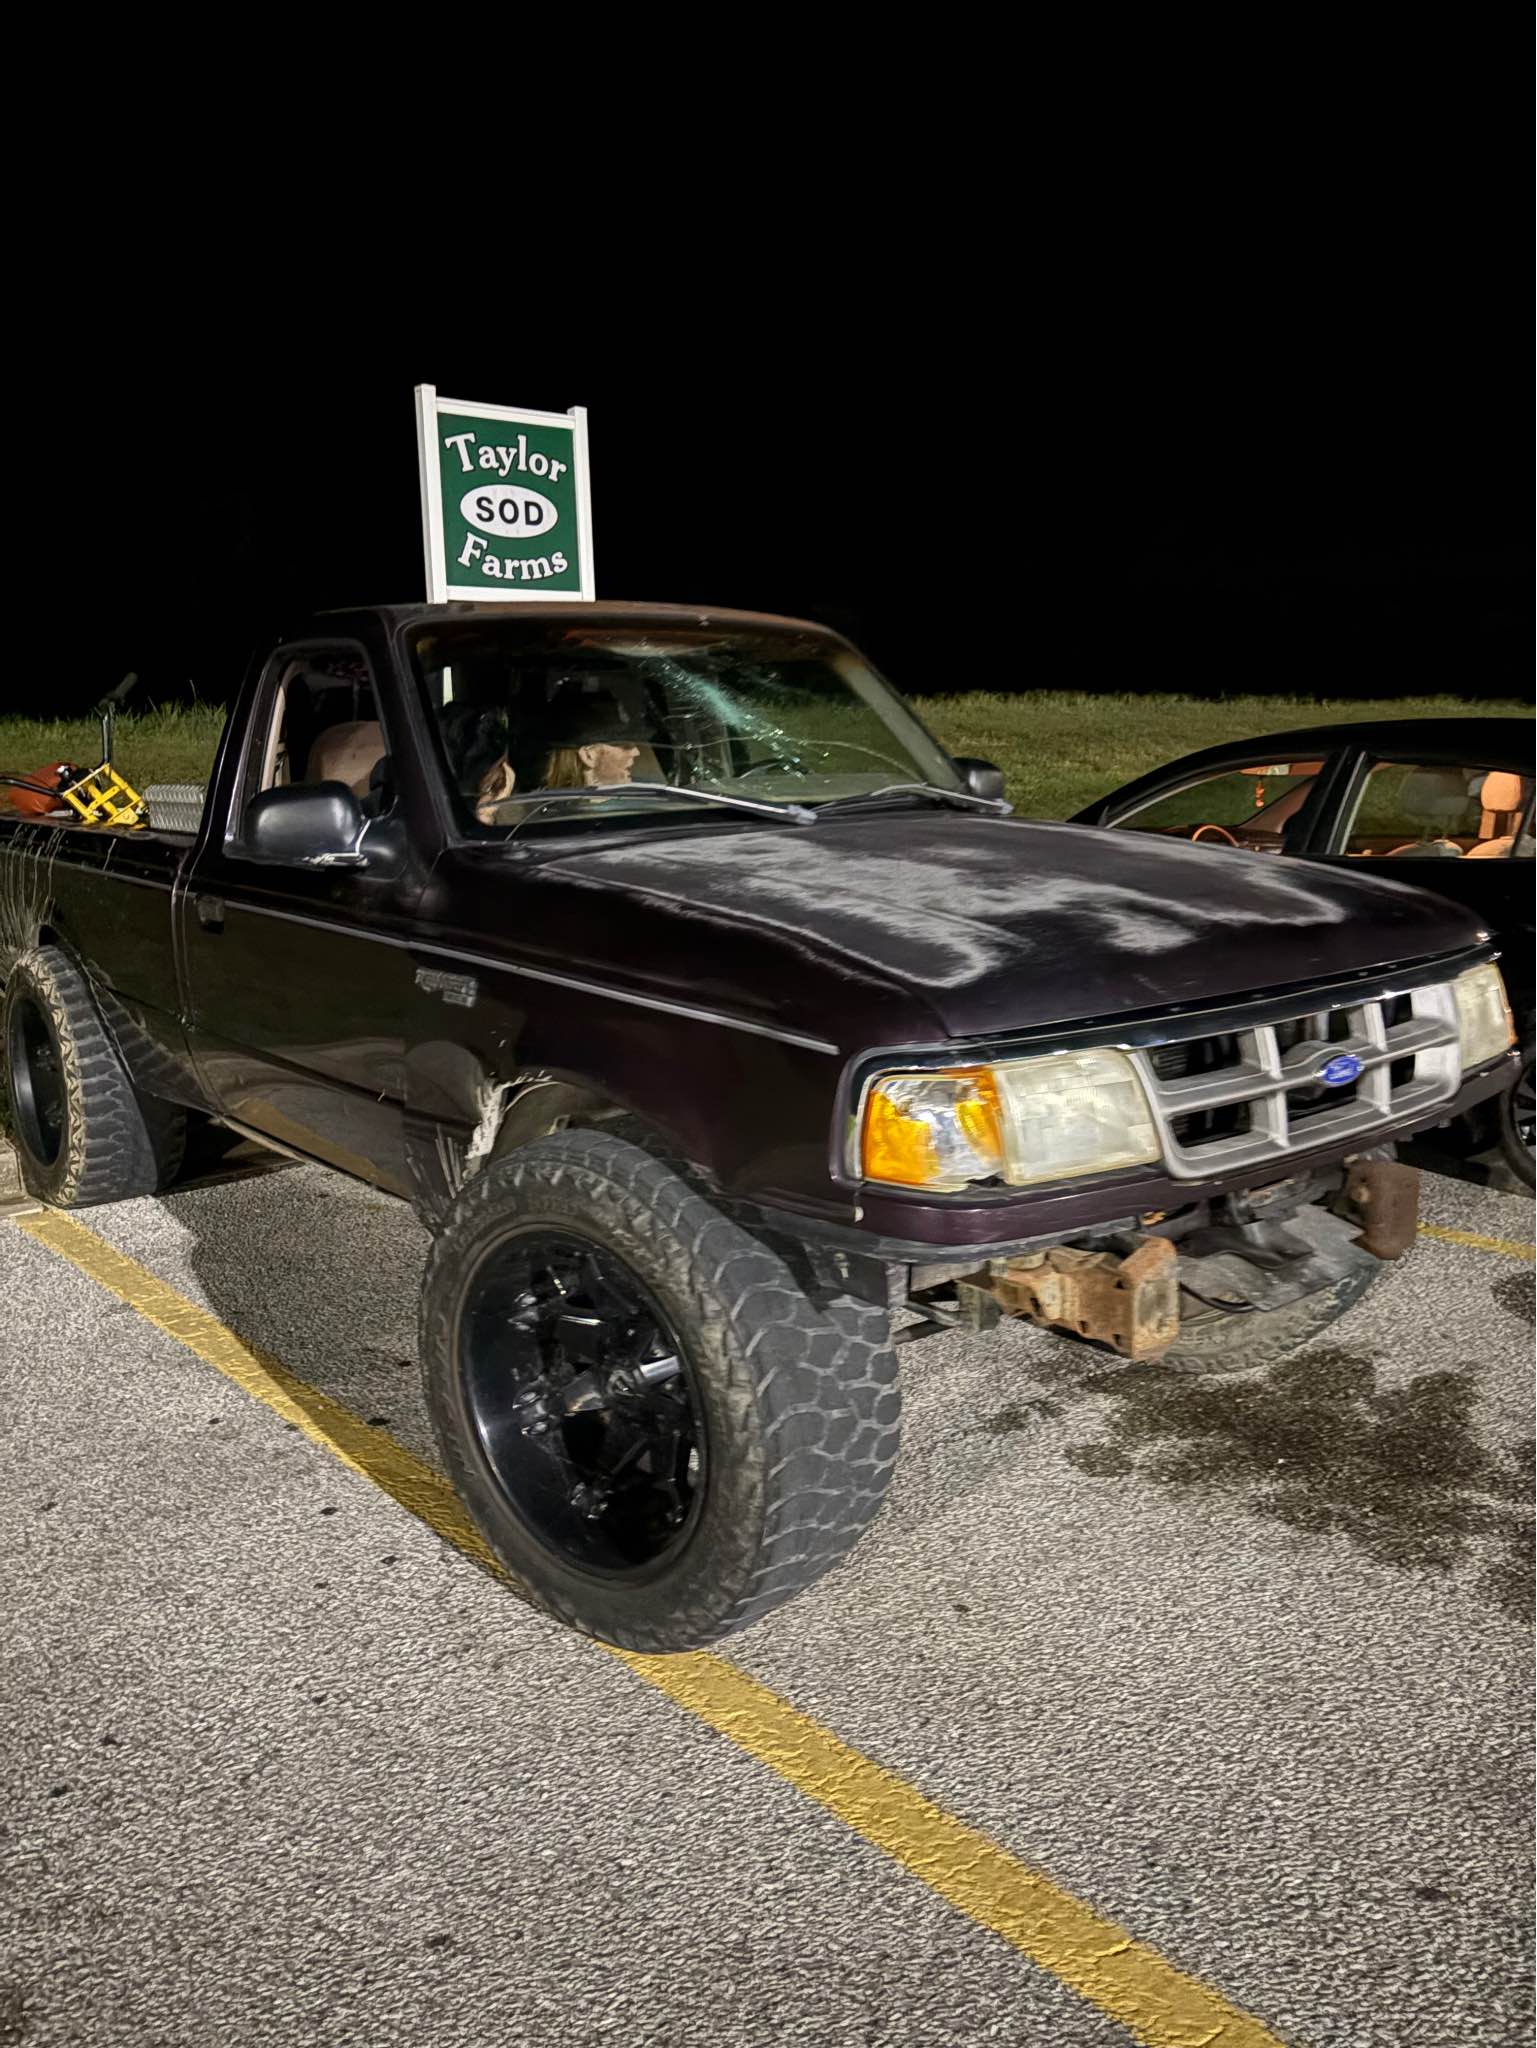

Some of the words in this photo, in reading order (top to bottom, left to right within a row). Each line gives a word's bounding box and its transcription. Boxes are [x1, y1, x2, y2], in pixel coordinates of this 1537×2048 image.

[445, 433, 567, 482] Taylor
[476, 496, 544, 526] SOD
[457, 532, 568, 580] Farms
